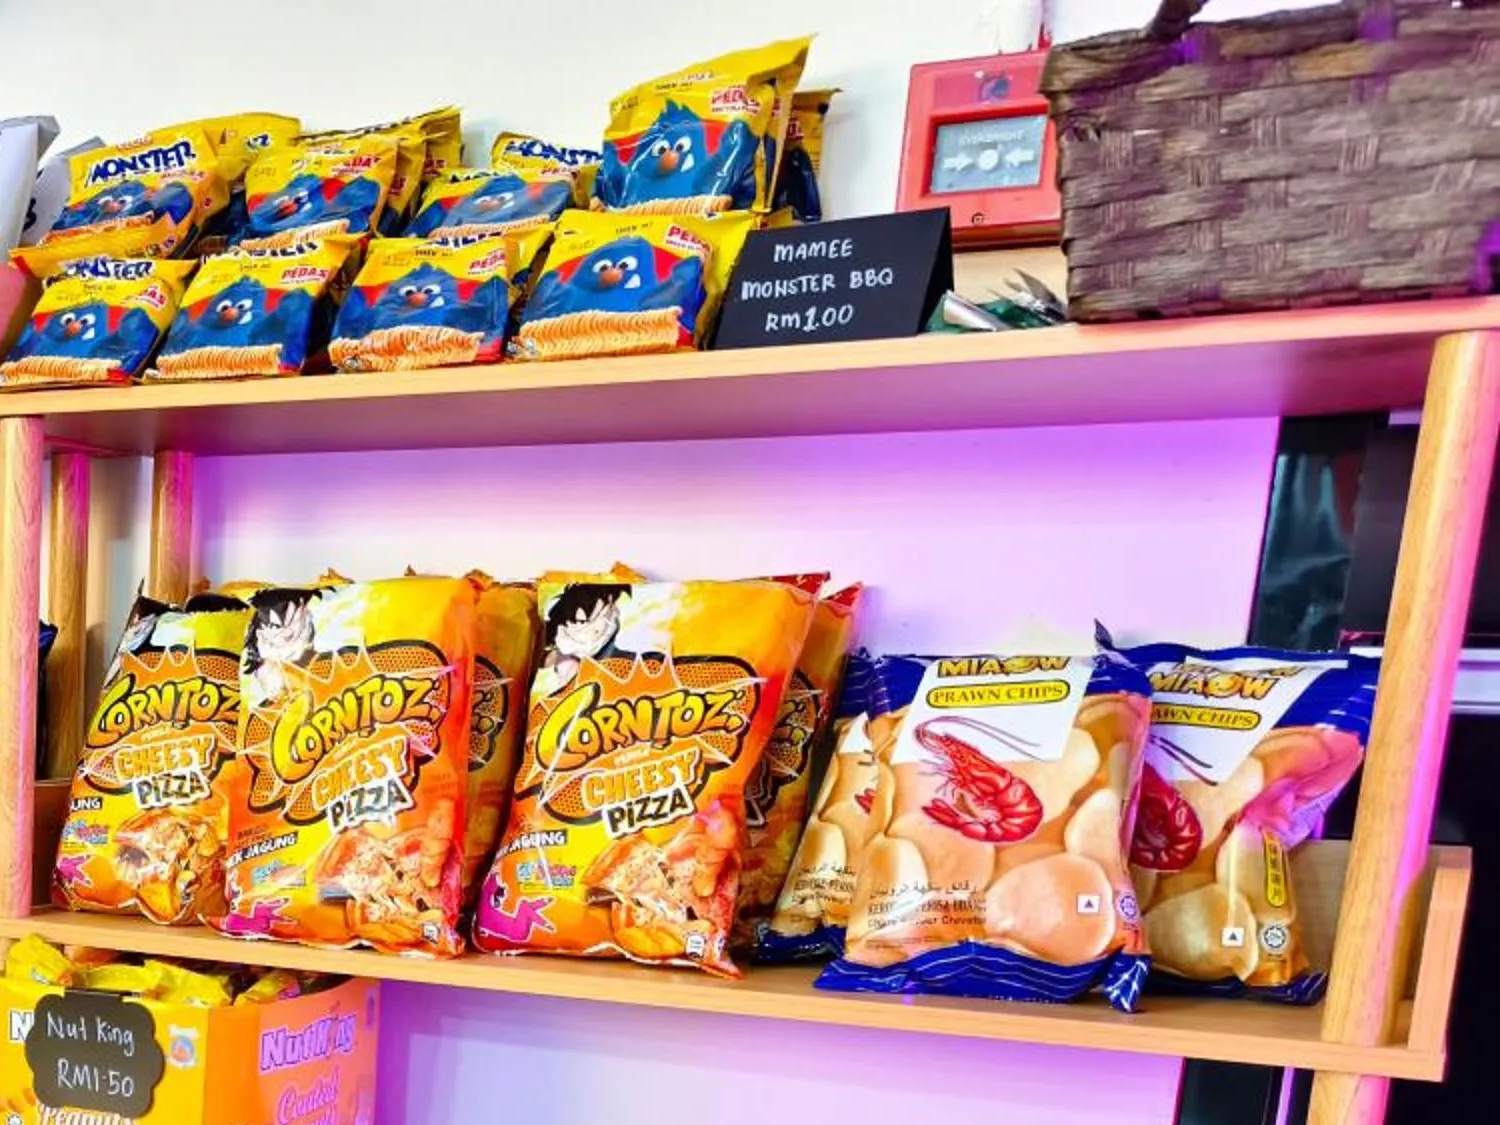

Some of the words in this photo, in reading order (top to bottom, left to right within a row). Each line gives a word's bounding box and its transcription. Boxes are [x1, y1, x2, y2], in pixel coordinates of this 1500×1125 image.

[504, 140, 602, 166] MONST
[774, 238, 852, 262] MAMEE
[280, 266, 330, 281] PEDAS
[741, 280, 836, 300] MONSTER
[850, 268, 893, 289] BBQ
[932, 689, 1007, 704] PRAWN
[1015, 685, 1064, 700] CHIPS
[1200, 709, 1255, 727] CHIPS
[114, 736, 211, 782] CHEESY
[312, 738, 409, 807] CHEESY
[583, 753, 699, 810] CHEESY
[47, 1015, 87, 1040] Nut
[95, 1016, 137, 1057] King
